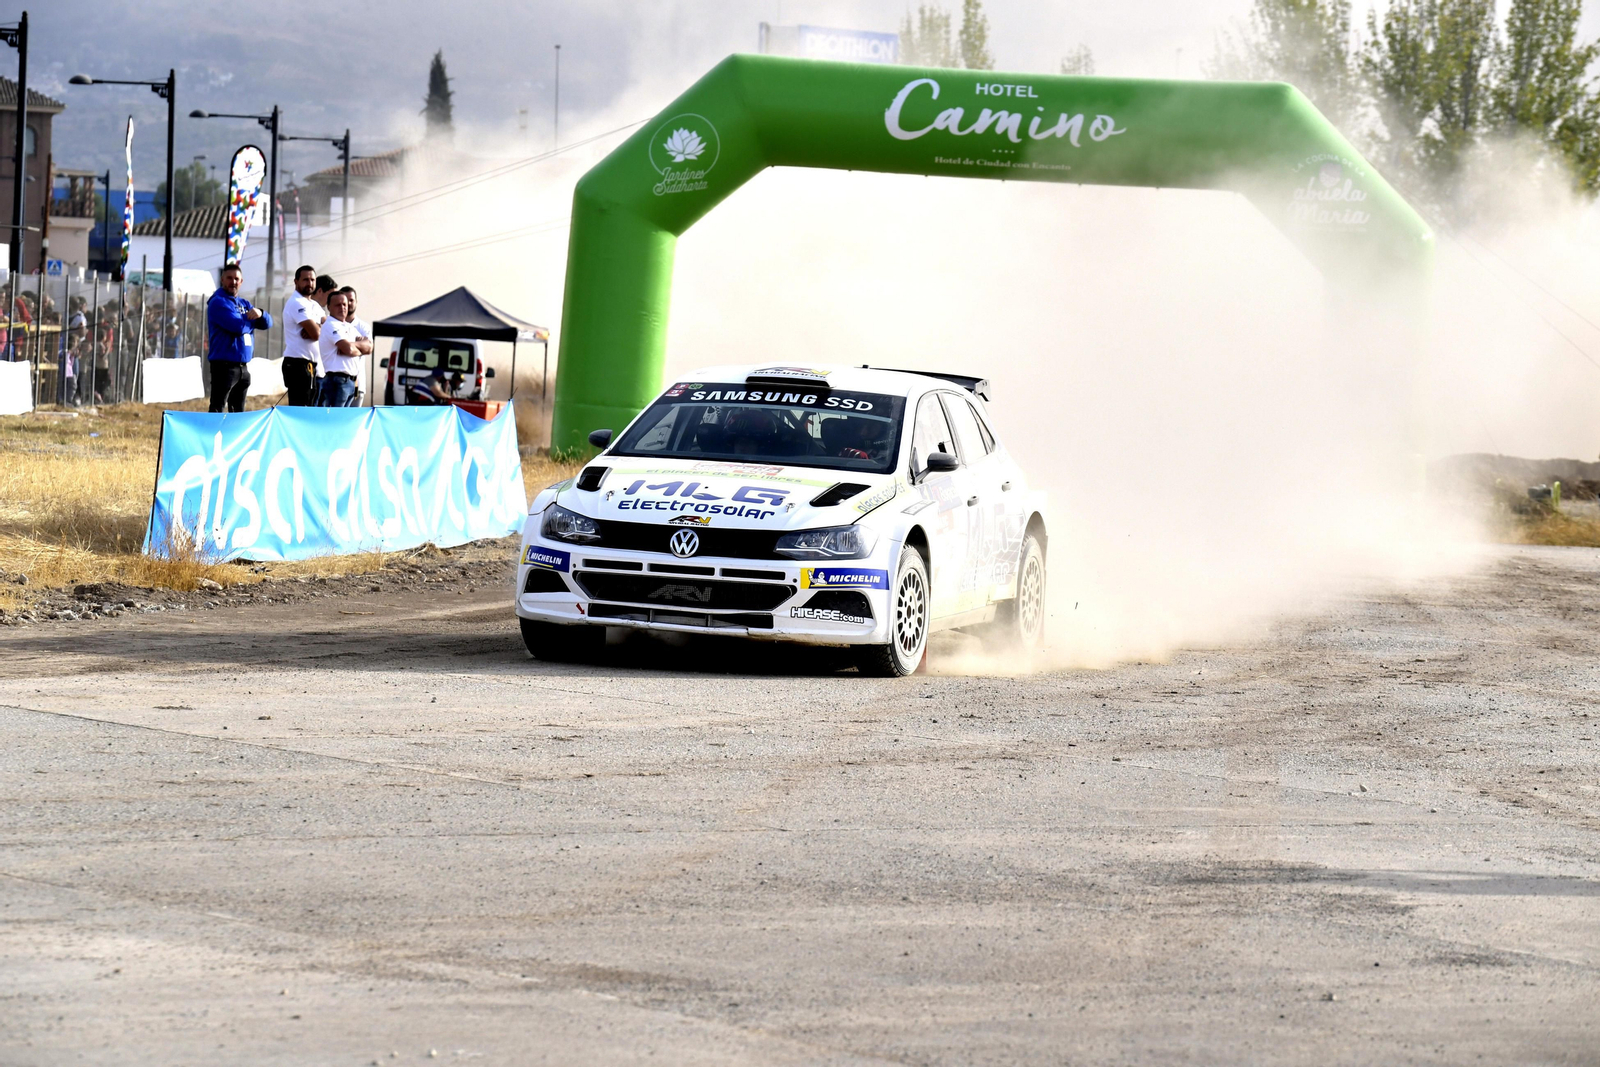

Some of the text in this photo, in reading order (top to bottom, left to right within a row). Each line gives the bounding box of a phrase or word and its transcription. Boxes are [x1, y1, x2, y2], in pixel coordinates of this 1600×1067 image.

[975, 83, 1039, 98] HOTEL
[884, 78, 1127, 147] Camino
[934, 156, 962, 165] Hotel
[962, 157, 974, 166] de
[976, 158, 1011, 168] Ciudad
[1032, 161, 1072, 171] Encanto
[1305, 153, 1340, 164] COCINA
[662, 166, 705, 184] Jardines
[690, 391, 874, 411] SAMSUNG SSD
[761, 474, 802, 483] libres
[530, 552, 563, 565] MICHELIN
[828, 574, 881, 583] MICHELIN
